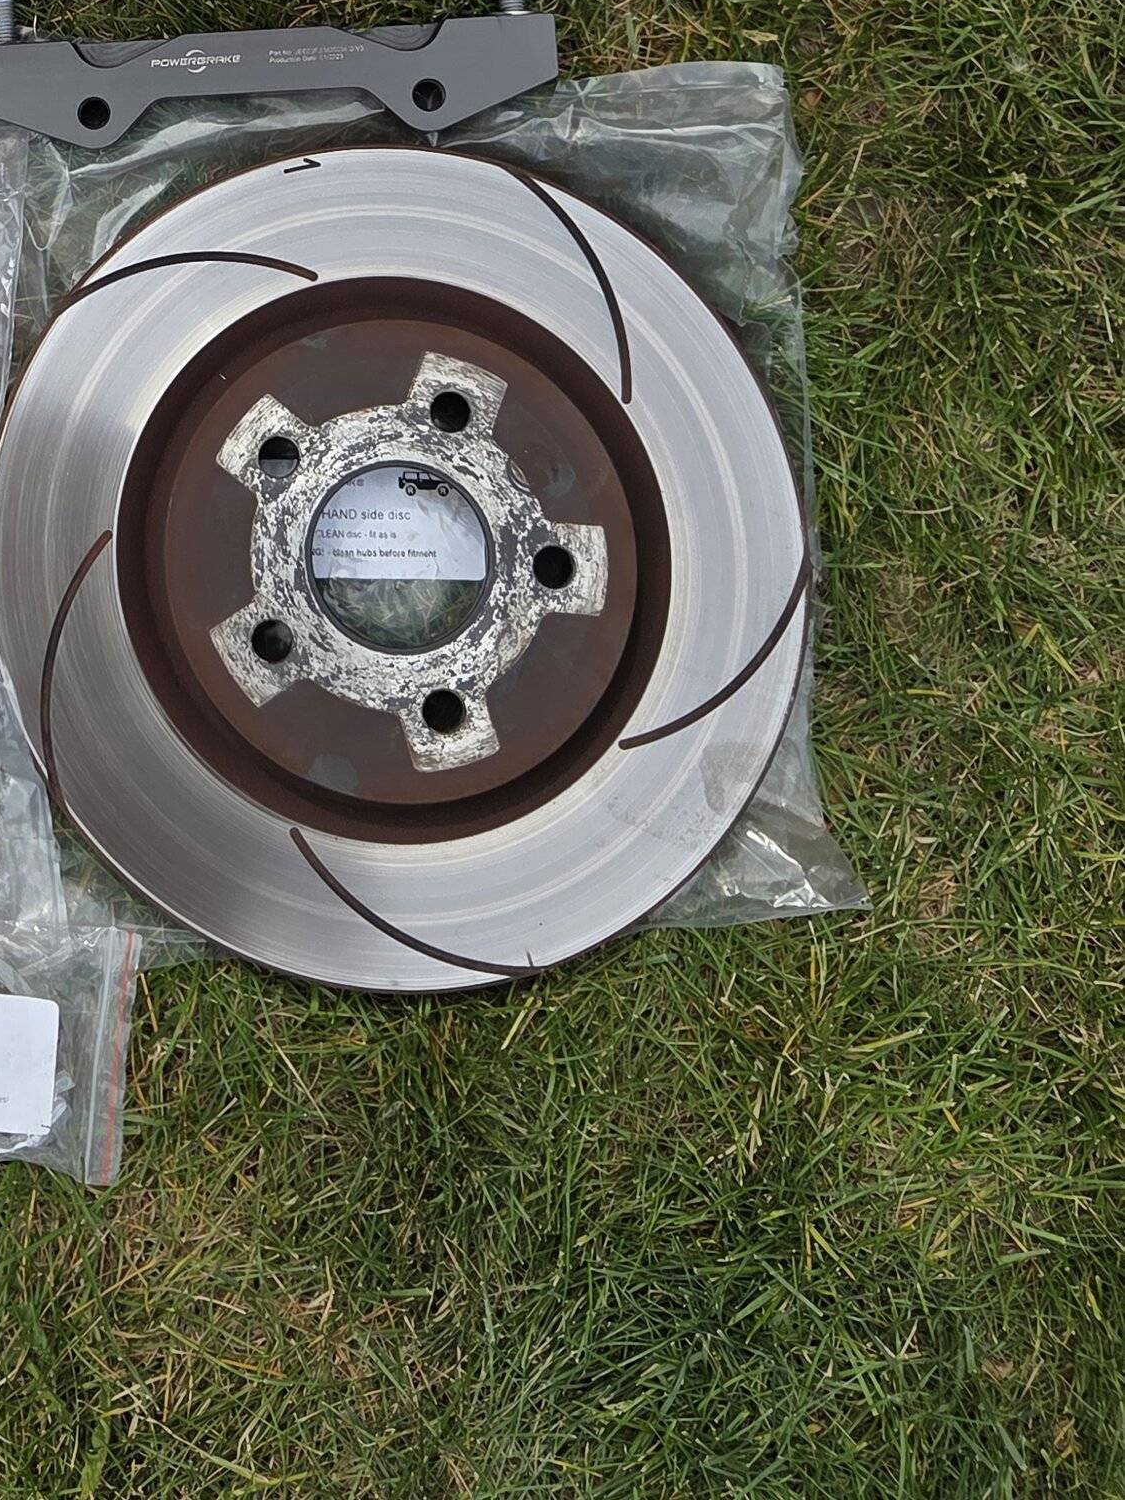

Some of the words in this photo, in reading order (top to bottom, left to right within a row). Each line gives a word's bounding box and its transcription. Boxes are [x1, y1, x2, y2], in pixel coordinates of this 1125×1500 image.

[150, 52, 241, 69] POWERBRAKE
[322, 508, 357, 520] HAND
[361, 509, 384, 521] side
[388, 509, 411, 521] disc
[356, 546, 377, 557] hubs
[379, 546, 406, 557] before
